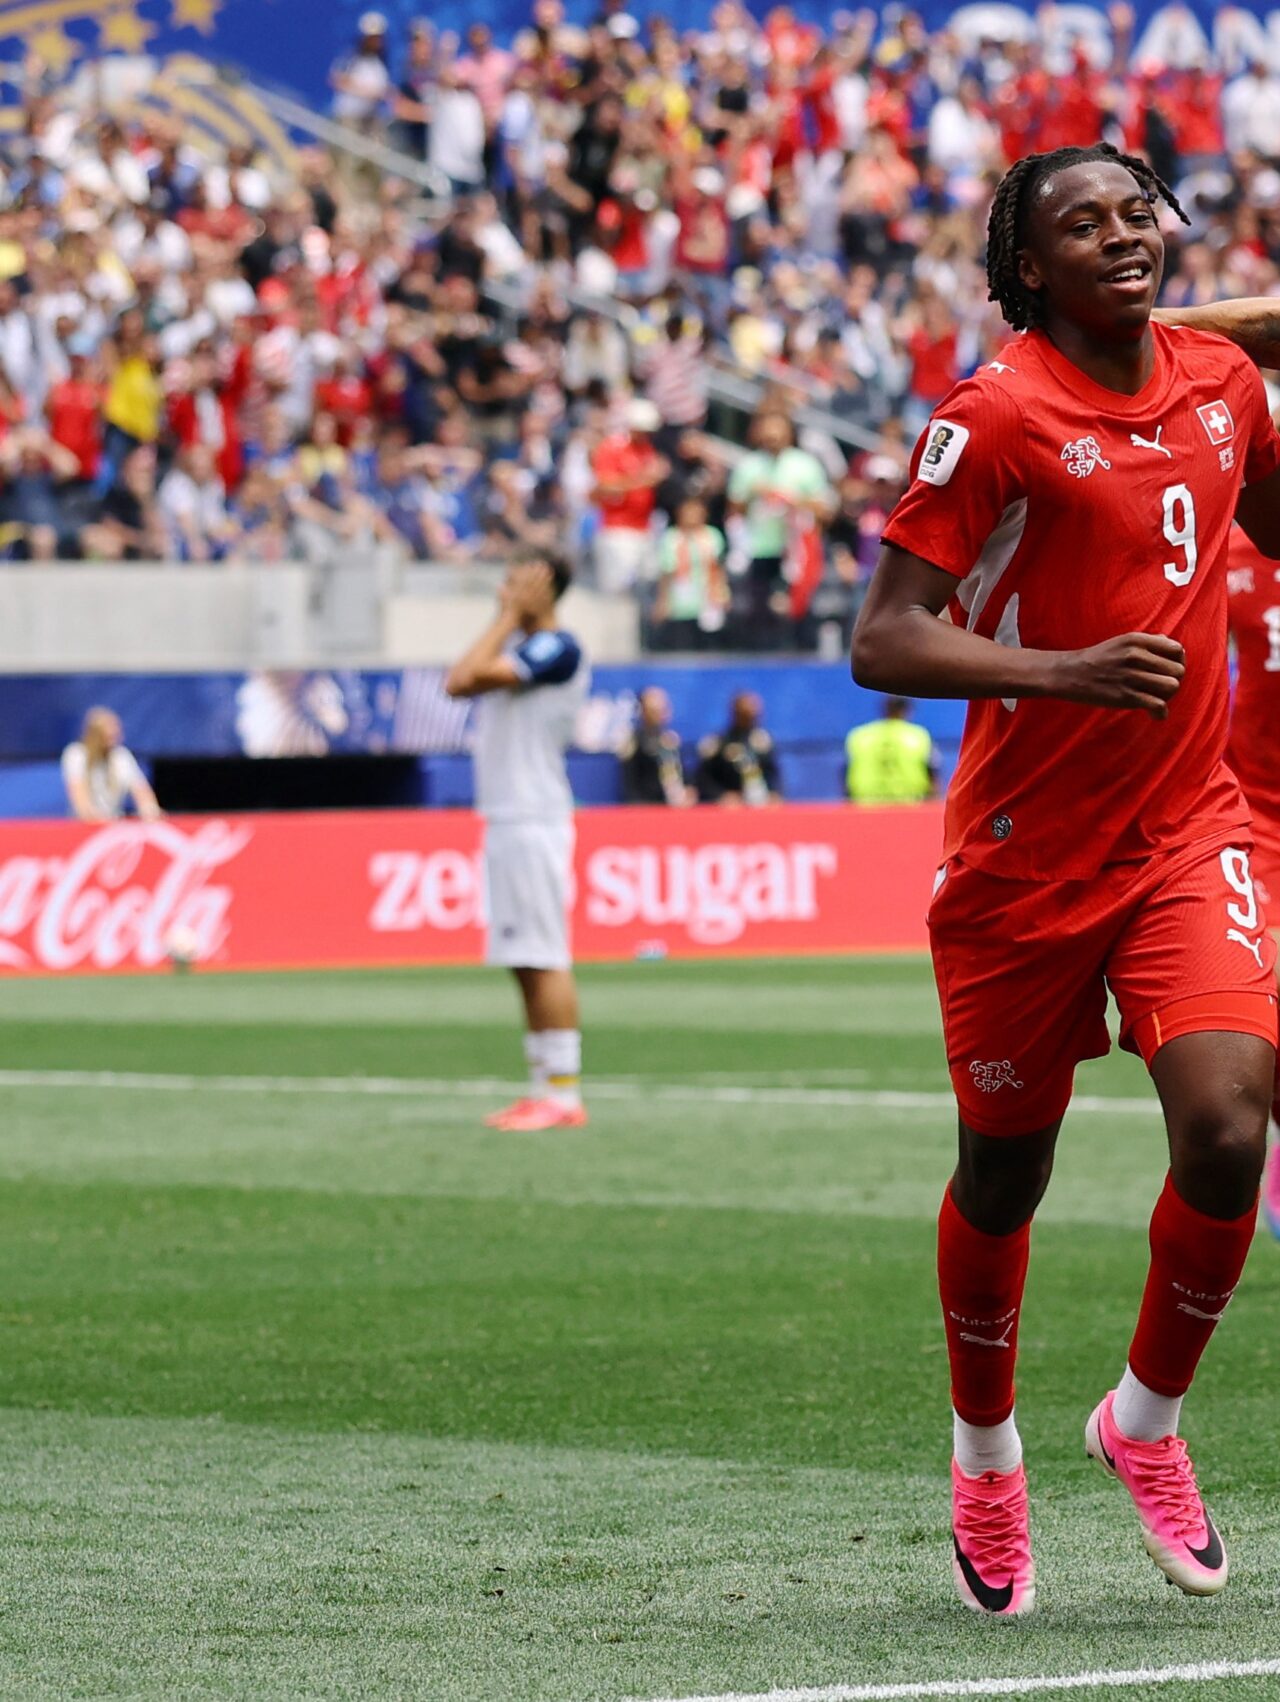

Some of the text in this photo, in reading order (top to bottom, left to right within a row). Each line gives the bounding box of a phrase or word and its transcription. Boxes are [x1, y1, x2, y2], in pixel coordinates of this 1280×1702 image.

[1161, 483, 1198, 587] 9
[367, 848, 578, 932] ze
[586, 842, 838, 945] sugar
[1219, 846, 1258, 930] 9
